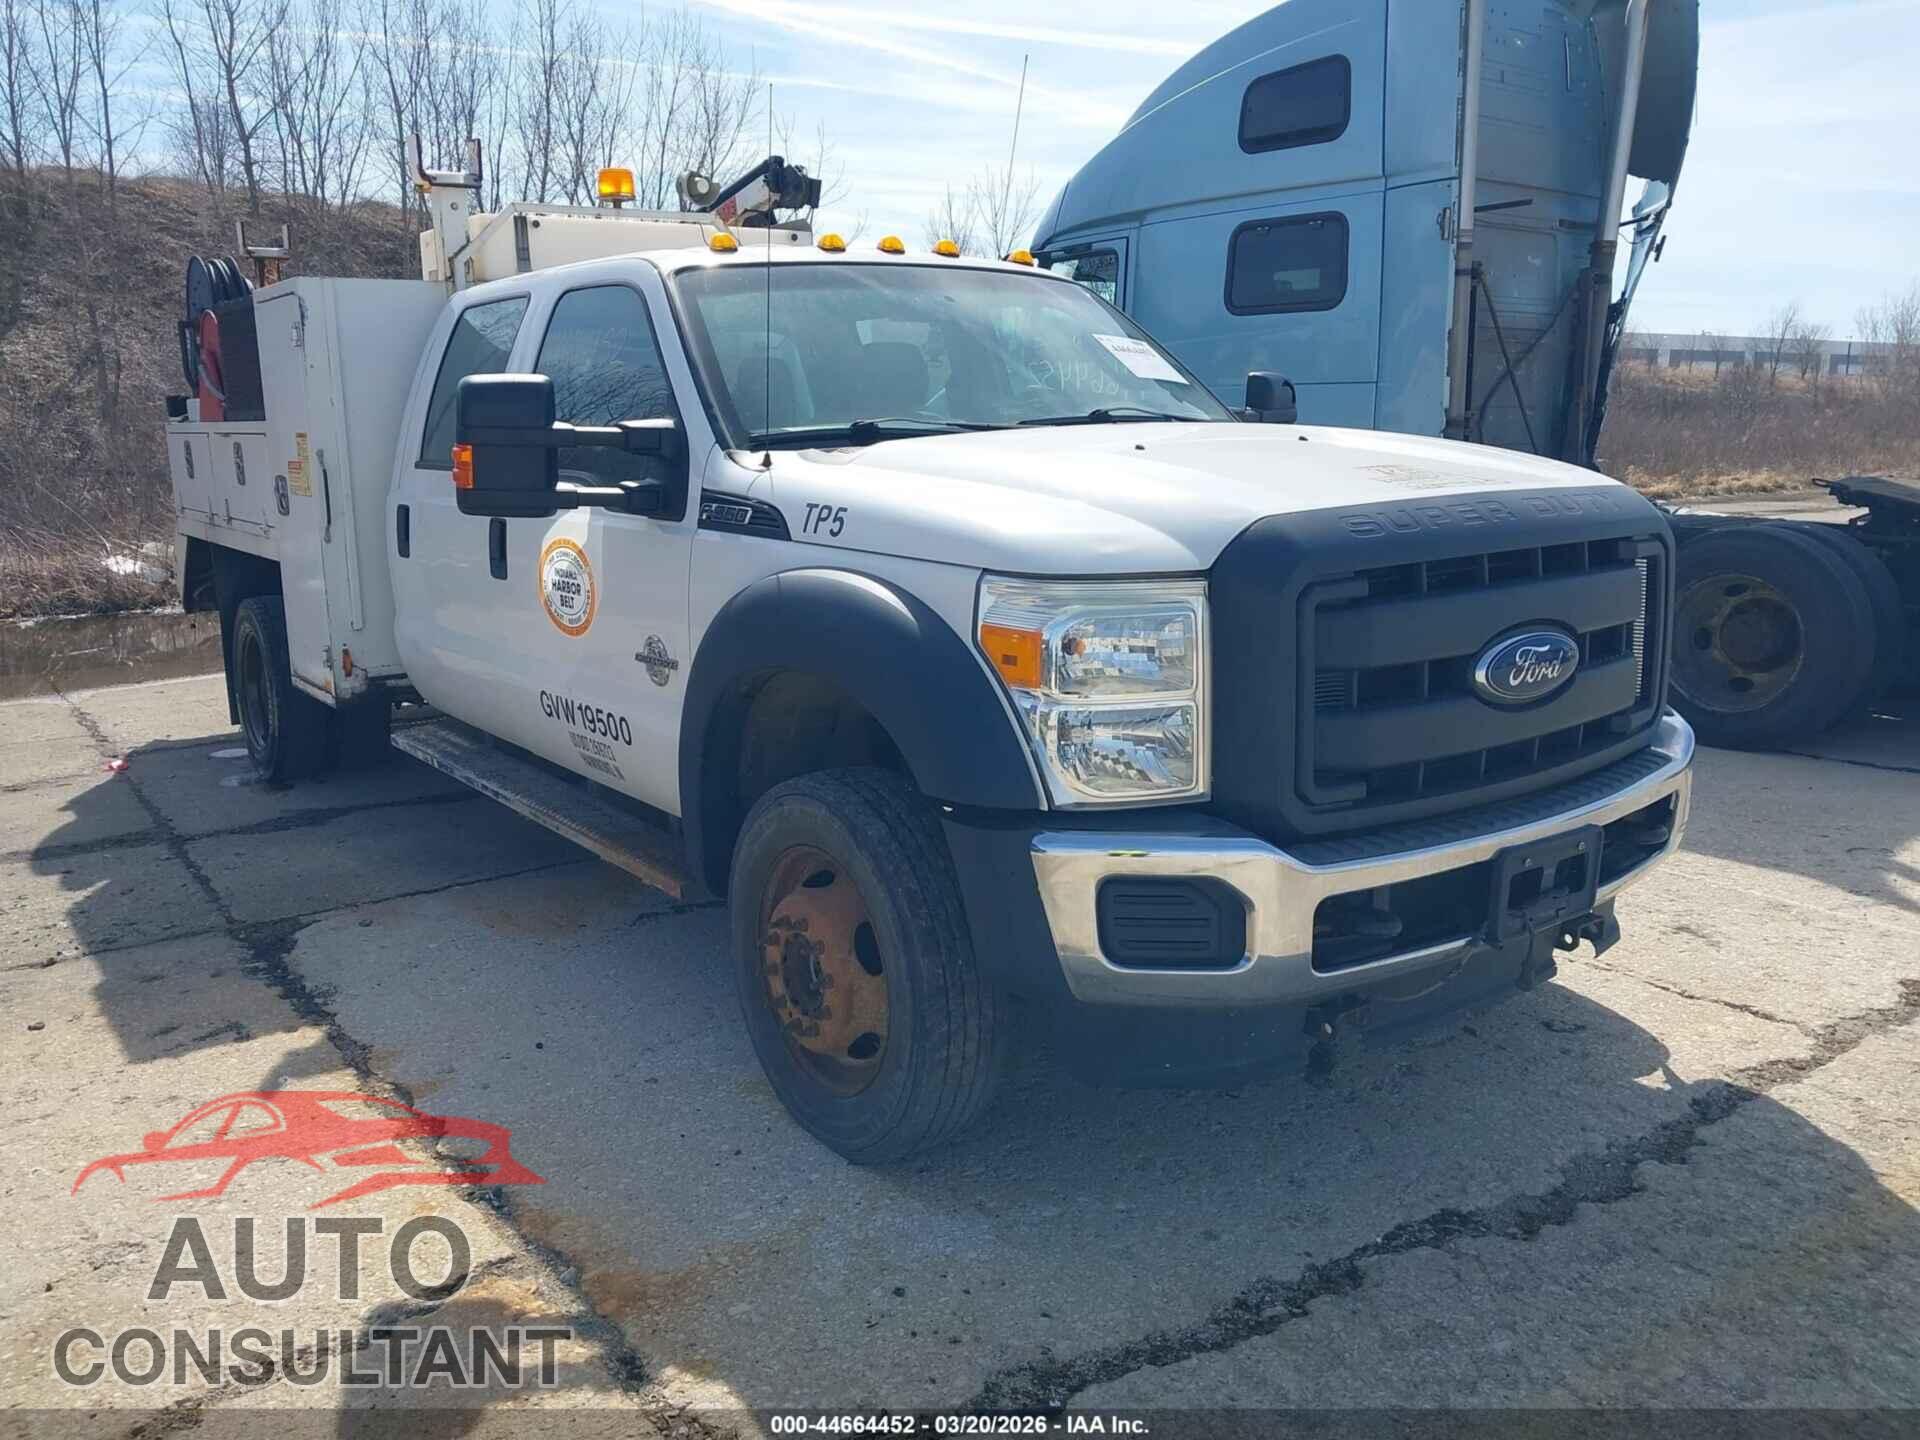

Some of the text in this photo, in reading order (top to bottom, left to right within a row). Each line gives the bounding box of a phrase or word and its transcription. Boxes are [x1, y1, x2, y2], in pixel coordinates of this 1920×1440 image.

[803, 503, 848, 537] TP5
[1338, 499, 1519, 539] SUPER
[552, 579, 582, 597] HARBOR
[560, 594, 575, 609] BELT
[1509, 644, 1564, 686] Ford
